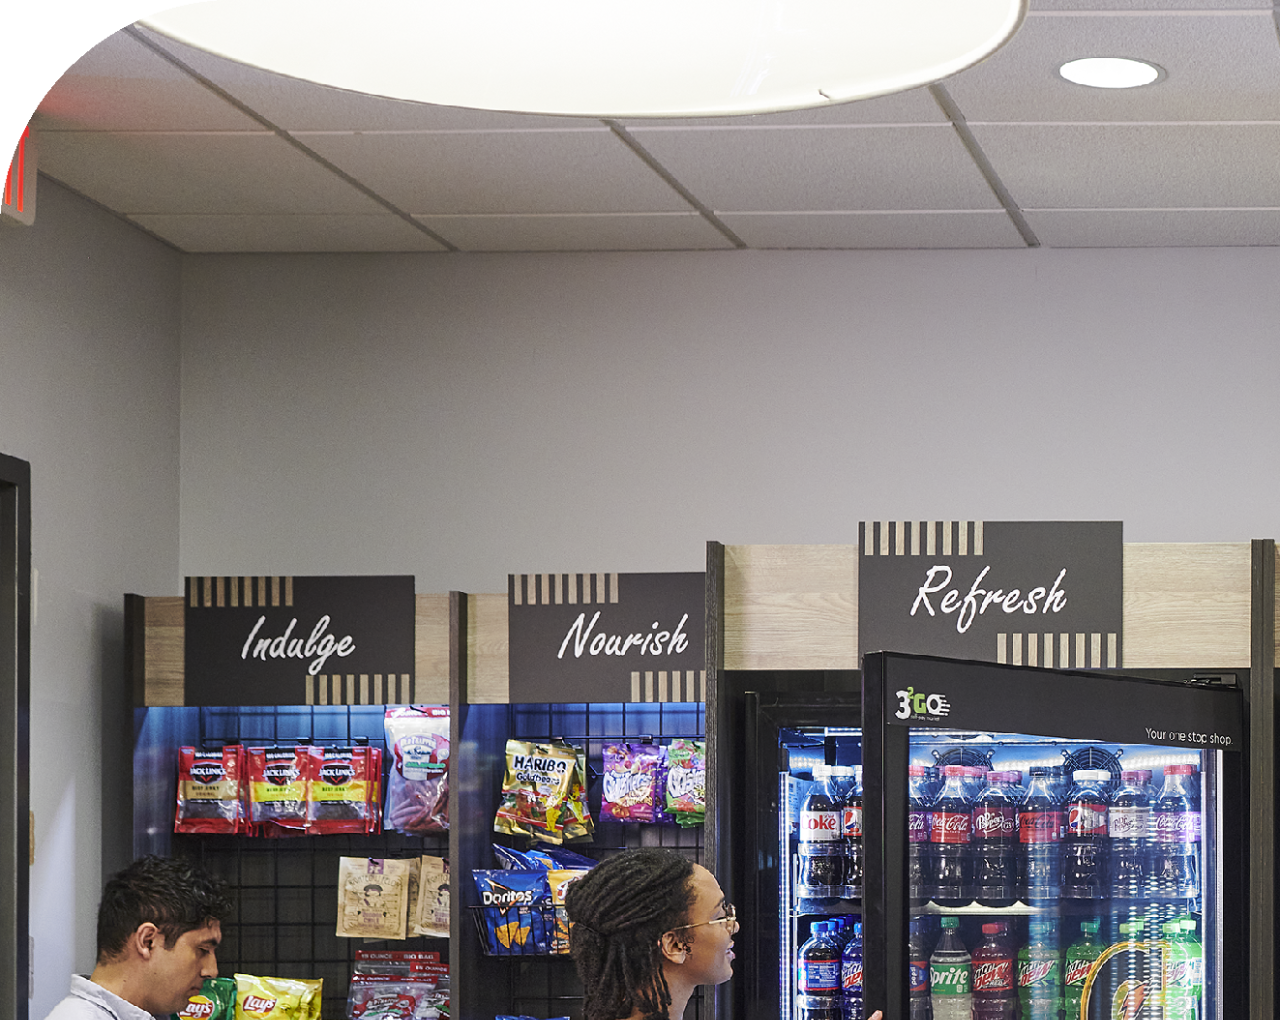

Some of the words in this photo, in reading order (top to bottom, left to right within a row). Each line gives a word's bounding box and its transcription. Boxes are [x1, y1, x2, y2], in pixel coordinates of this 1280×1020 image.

[909, 565, 1067, 633] Refresh
[557, 611, 689, 659] Nourish
[241, 615, 356, 676] Indulge
[1145, 727, 1166, 741] Your
[1188, 731, 1208, 746] stop
[513, 755, 567, 774] HARIBO
[802, 814, 836, 830] Coke
[483, 890, 532, 905] Doritos
[930, 968, 968, 985] Sprite
[243, 995, 277, 1011] Lay's
